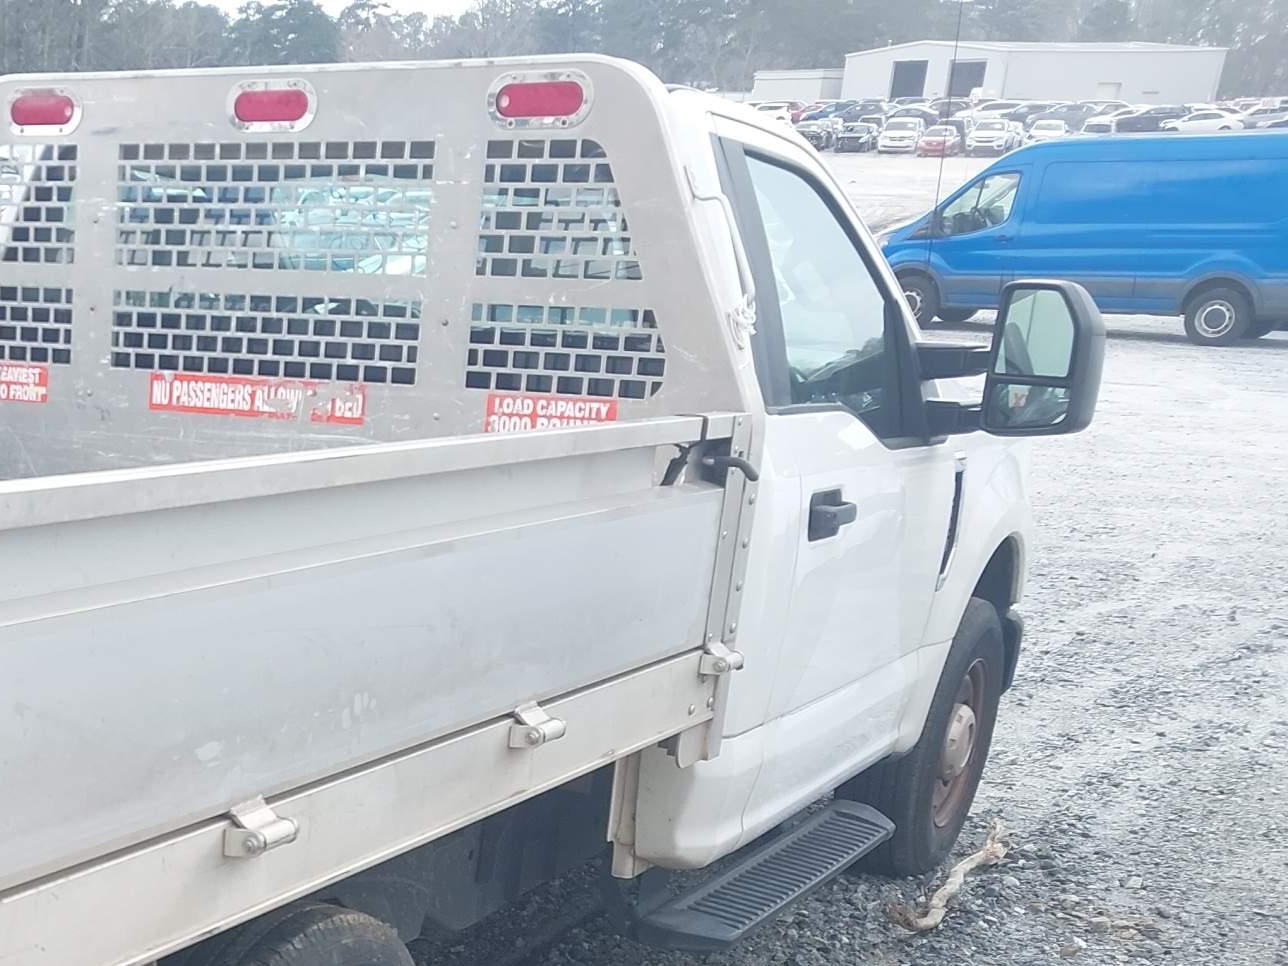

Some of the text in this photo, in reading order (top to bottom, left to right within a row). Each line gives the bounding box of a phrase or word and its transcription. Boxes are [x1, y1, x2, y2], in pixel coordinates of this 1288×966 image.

[9, 385, 46, 402] FRONT
[152, 379, 170, 404] NO
[172, 381, 252, 410] PASSENGERS
[494, 398, 610, 419] LOAD CAPACITY
[488, 415, 532, 432] 3000
